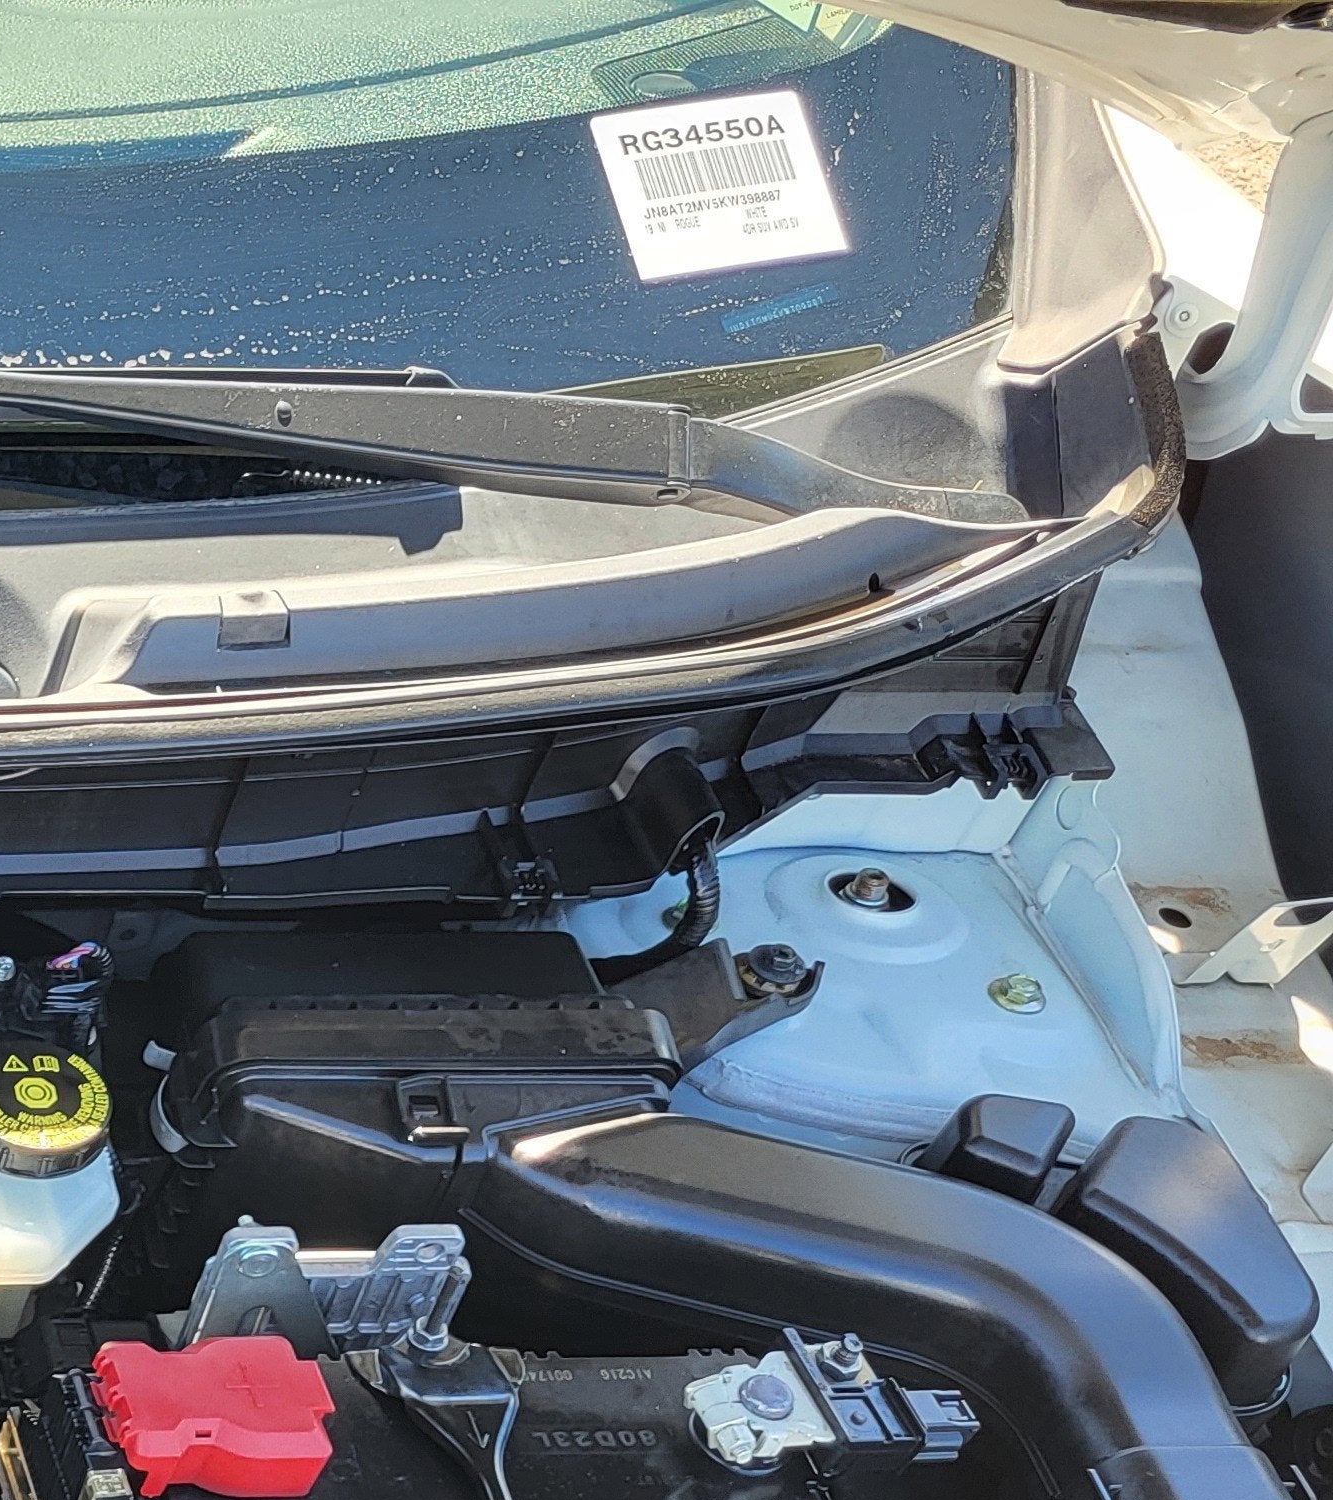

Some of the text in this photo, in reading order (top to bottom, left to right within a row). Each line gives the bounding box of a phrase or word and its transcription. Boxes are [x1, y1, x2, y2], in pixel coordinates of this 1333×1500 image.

[617, 114, 786, 156] RG34550A
[644, 189, 781, 220] JN8AT2MV5KW398887
[17, 1110, 68, 1126] WARNING
[532, 1429, 657, 1448] 80D23L
